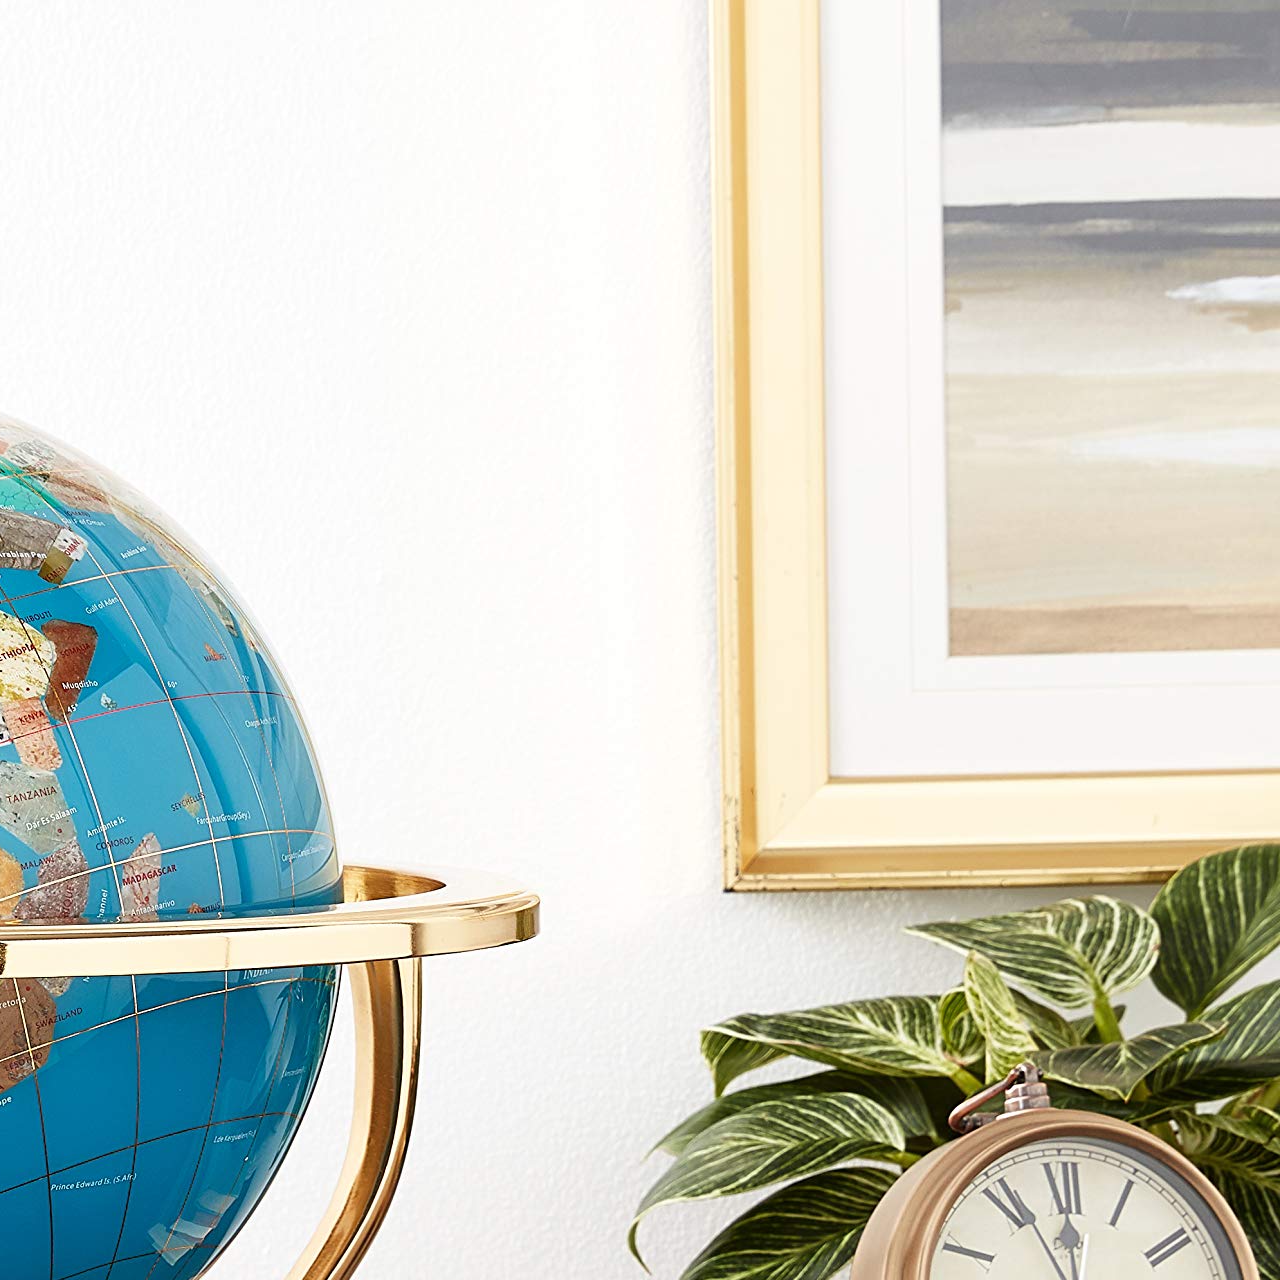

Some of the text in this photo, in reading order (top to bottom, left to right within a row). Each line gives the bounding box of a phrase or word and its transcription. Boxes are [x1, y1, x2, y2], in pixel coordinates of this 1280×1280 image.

[31, 551, 47, 559] Pen
[86, 603, 98, 615] Gulf
[60, 643, 91, 658] SOMALIA
[62, 680, 98, 690] Muqdisho
[18, 710, 45, 724] KENYA
[6, 786, 58, 804] TANZANIA
[25, 820, 40, 831] Dar
[50, 807, 78, 824] Salaam
[96, 836, 135, 851] COMOROS
[21, 855, 55, 871] MALAWI
[122, 864, 177, 887] MADAGASCAR
[130, 899, 176, 916] Antananarivo
[35, 1007, 83, 1030] SWAZILAND
[50, 1183, 75, 1191] Prince
[75, 1179, 103, 1189] Edward
